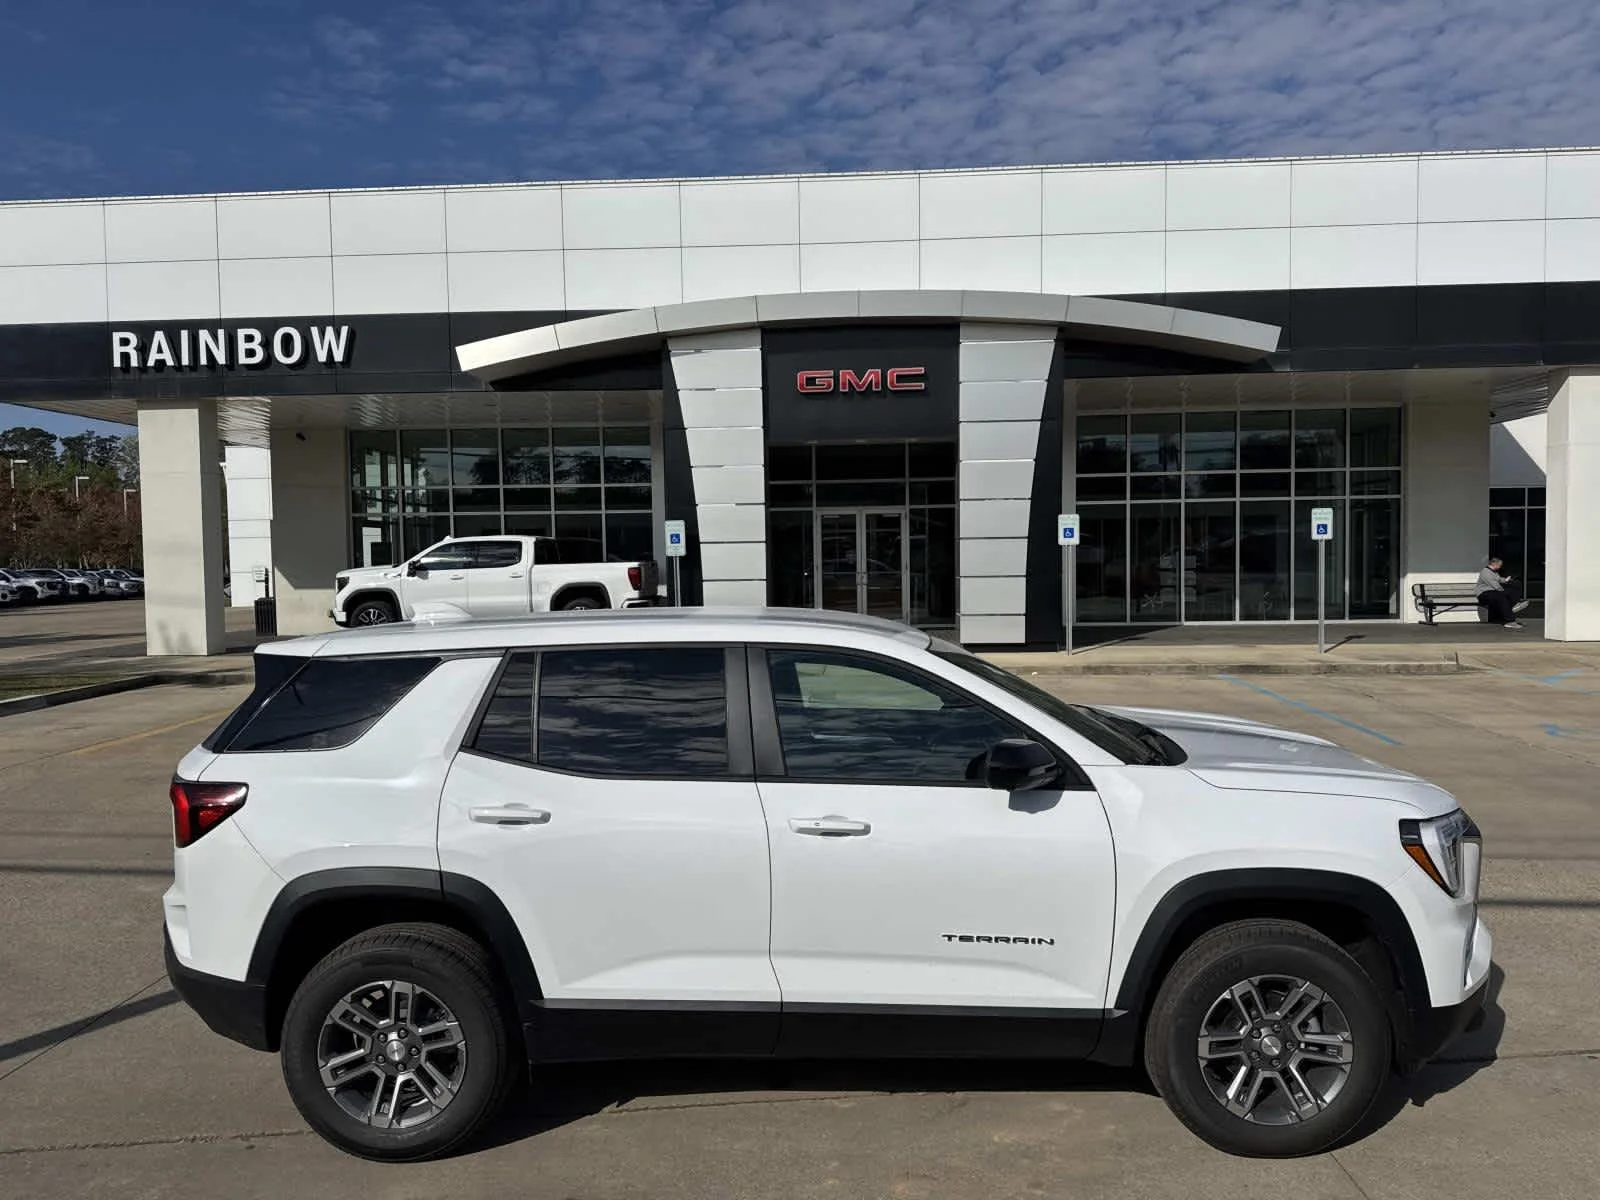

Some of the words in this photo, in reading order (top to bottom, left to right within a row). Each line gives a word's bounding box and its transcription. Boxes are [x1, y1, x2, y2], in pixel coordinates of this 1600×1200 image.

[112, 325, 349, 368] RAINBOW
[797, 367, 925, 392] GMC
[941, 934, 1055, 946] TERRAIN
